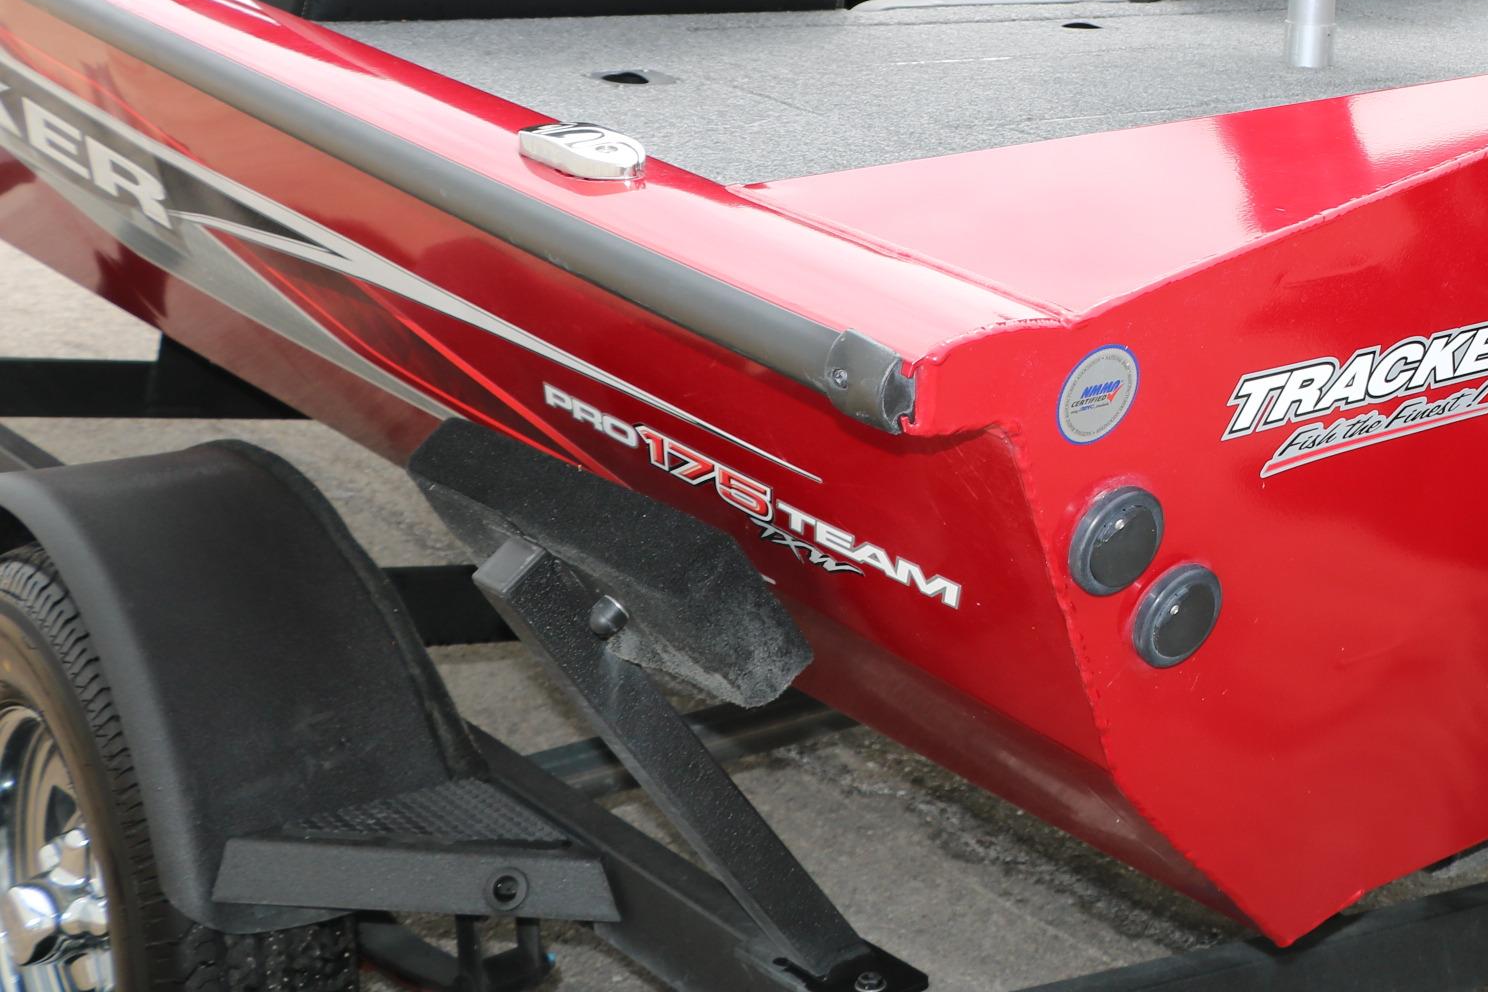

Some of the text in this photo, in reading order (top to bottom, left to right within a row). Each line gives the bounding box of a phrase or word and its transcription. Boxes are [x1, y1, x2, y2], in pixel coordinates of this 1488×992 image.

[1071, 394, 1107, 408] CERTIFIED
[1081, 379, 1121, 399] NMMA
[1277, 424, 1338, 457] Fish
[1341, 407, 1382, 439] the
[543, 381, 963, 610] PRO 175 TEAM
